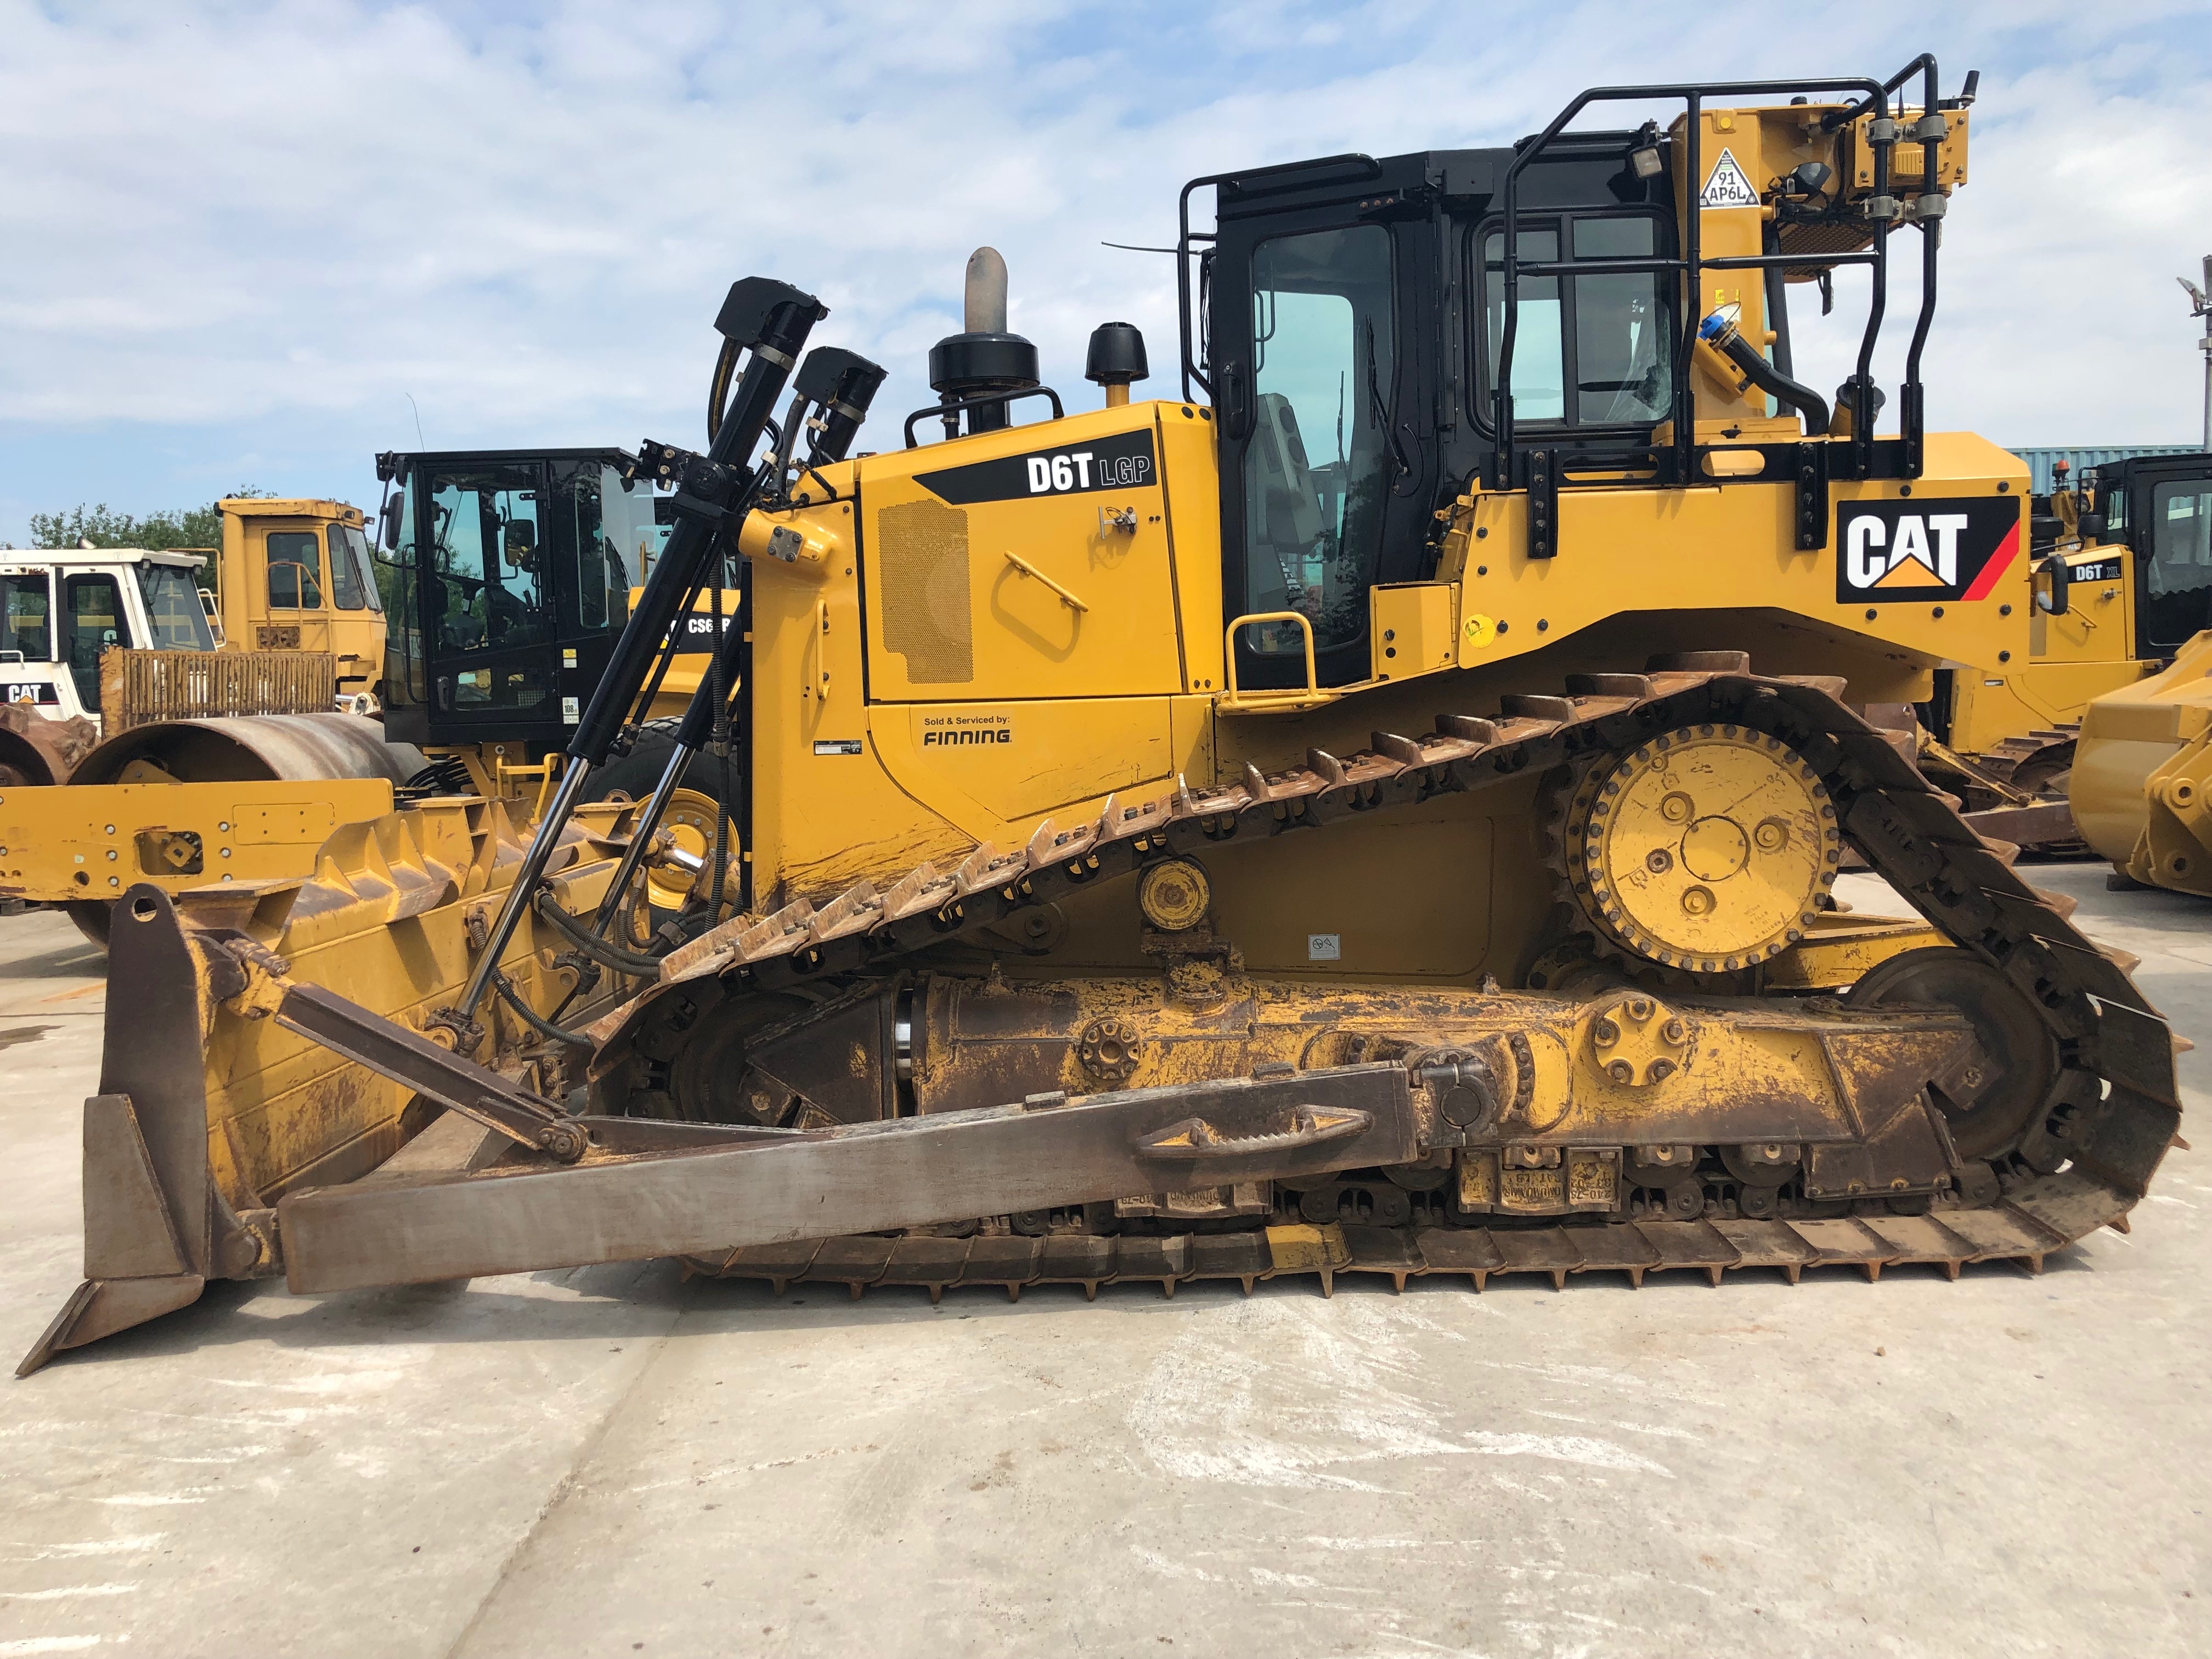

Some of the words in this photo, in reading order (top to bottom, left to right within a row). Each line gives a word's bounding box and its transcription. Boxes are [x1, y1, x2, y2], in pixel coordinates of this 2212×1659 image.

[1718, 171, 1736, 186] 91
[1709, 186, 1746, 201] AP6L
[1027, 452, 1093, 493] D6T
[1099, 456, 1150, 486] LGP
[1847, 514, 1968, 589] CAT
[2076, 564, 2103, 581] D6T
[8, 684, 42, 704] CAT
[564, 704, 574, 713] 108
[924, 718, 944, 726] Sold
[956, 715, 994, 725] Serviced
[996, 715, 1010, 725] by:
[924, 729, 1011, 746] FINNING
